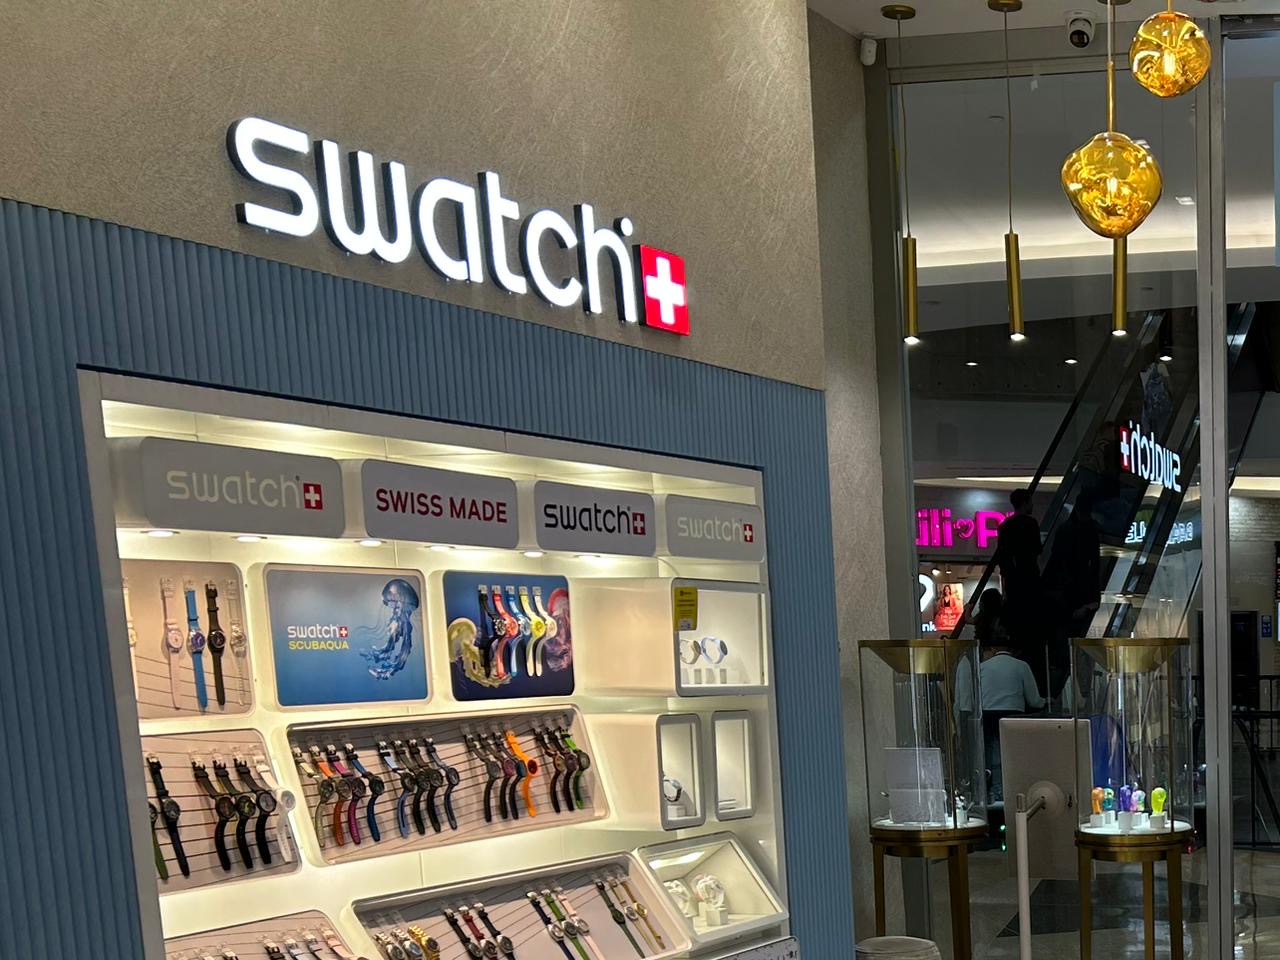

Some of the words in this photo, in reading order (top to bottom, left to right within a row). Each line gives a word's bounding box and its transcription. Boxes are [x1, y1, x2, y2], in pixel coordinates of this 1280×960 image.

[228, 117, 638, 324] swatch
[167, 470, 300, 508] swatch
[376, 488, 443, 518] SWISS
[449, 496, 508, 523] MADE
[544, 503, 631, 535] swatch
[677, 517, 743, 543] swatch
[915, 508, 953, 547] ili
[287, 624, 339, 639] swatch
[288, 641, 349, 650] SCUBAQUA
